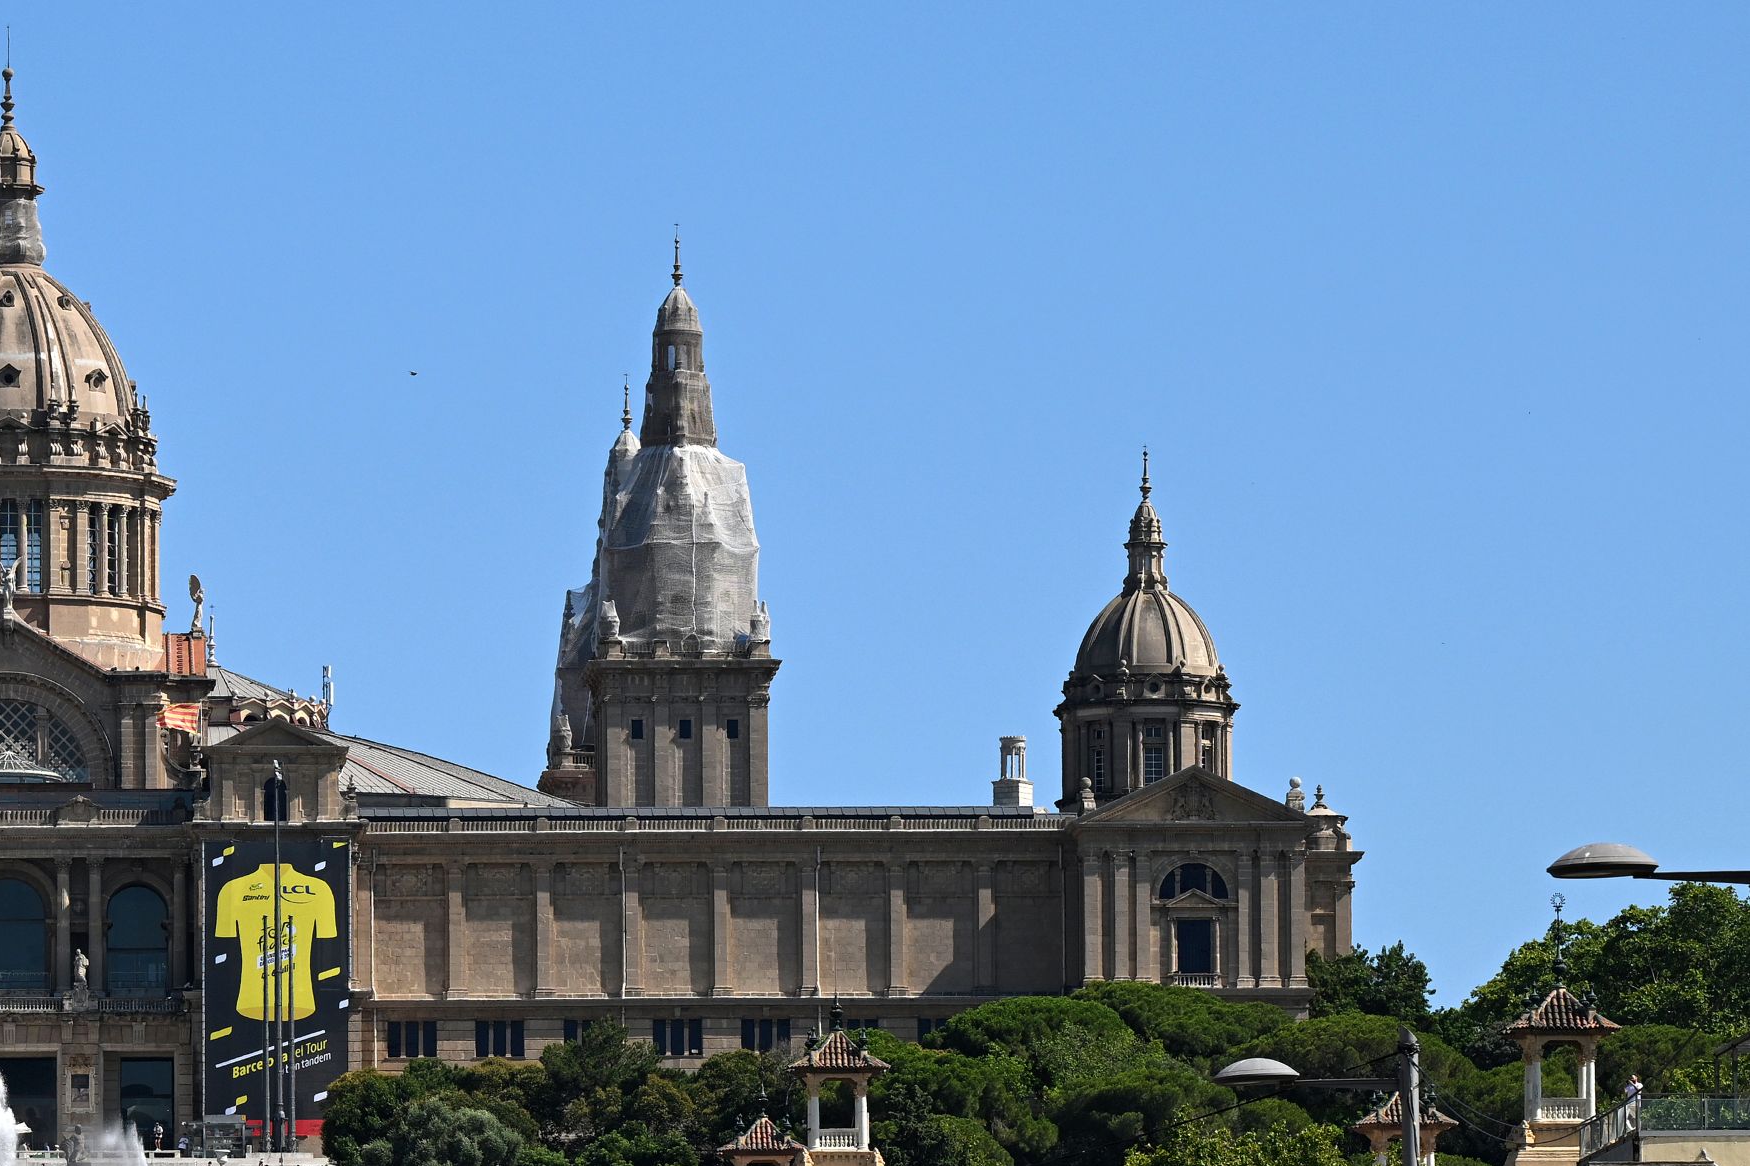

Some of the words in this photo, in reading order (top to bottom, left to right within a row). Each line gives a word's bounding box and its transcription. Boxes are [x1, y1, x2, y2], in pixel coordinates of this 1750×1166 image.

[282, 885, 316, 896] LCL
[232, 1052, 288, 1079] Barceoa
[295, 1045, 304, 1058] el
[306, 1040, 328, 1055] Tour
[301, 1052, 332, 1069] tandem
